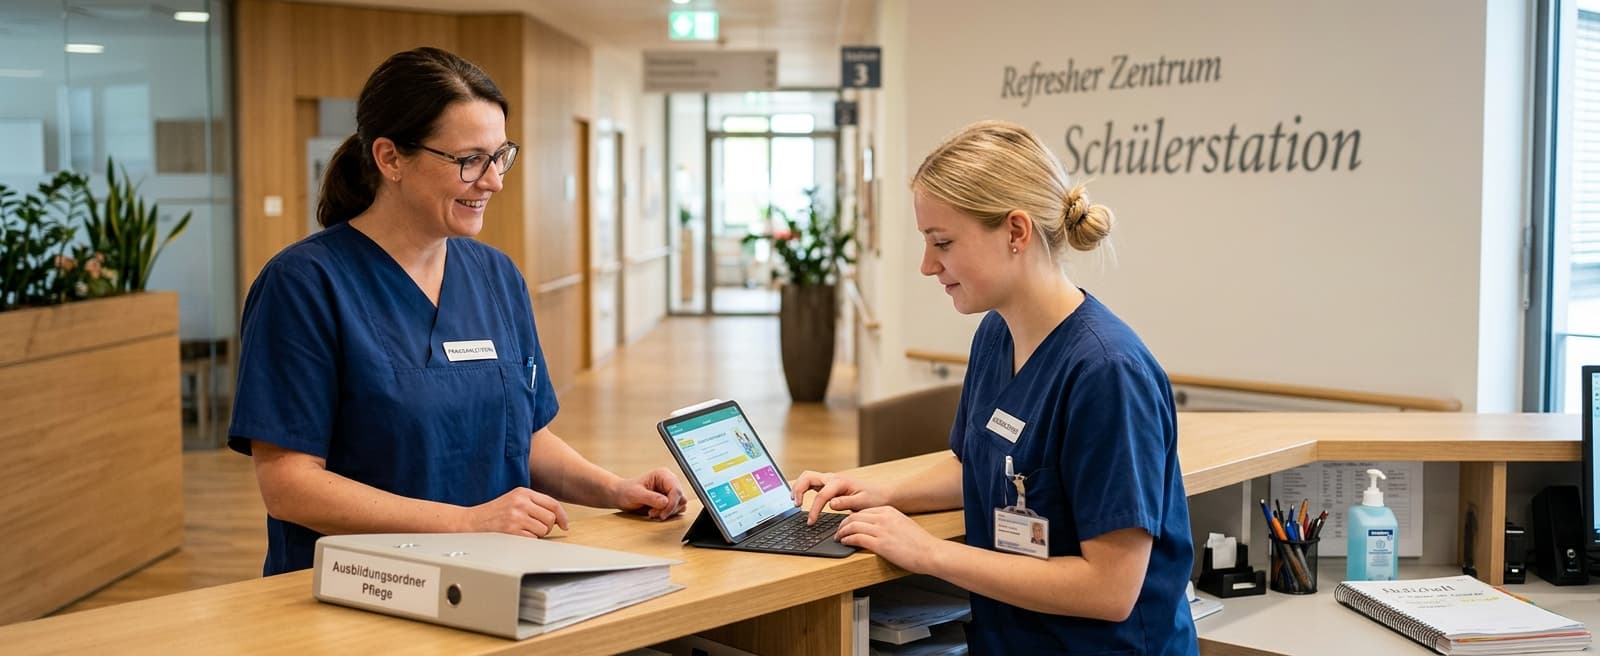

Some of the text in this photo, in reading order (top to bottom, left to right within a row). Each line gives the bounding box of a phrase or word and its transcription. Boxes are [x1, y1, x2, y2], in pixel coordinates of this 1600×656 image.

[853, 63, 869, 86] 3
[1001, 54, 1222, 107] Refresher Zentrum
[1063, 114, 1363, 175] Schülerstation
[332, 561, 426, 588] Ausbildungsordner
